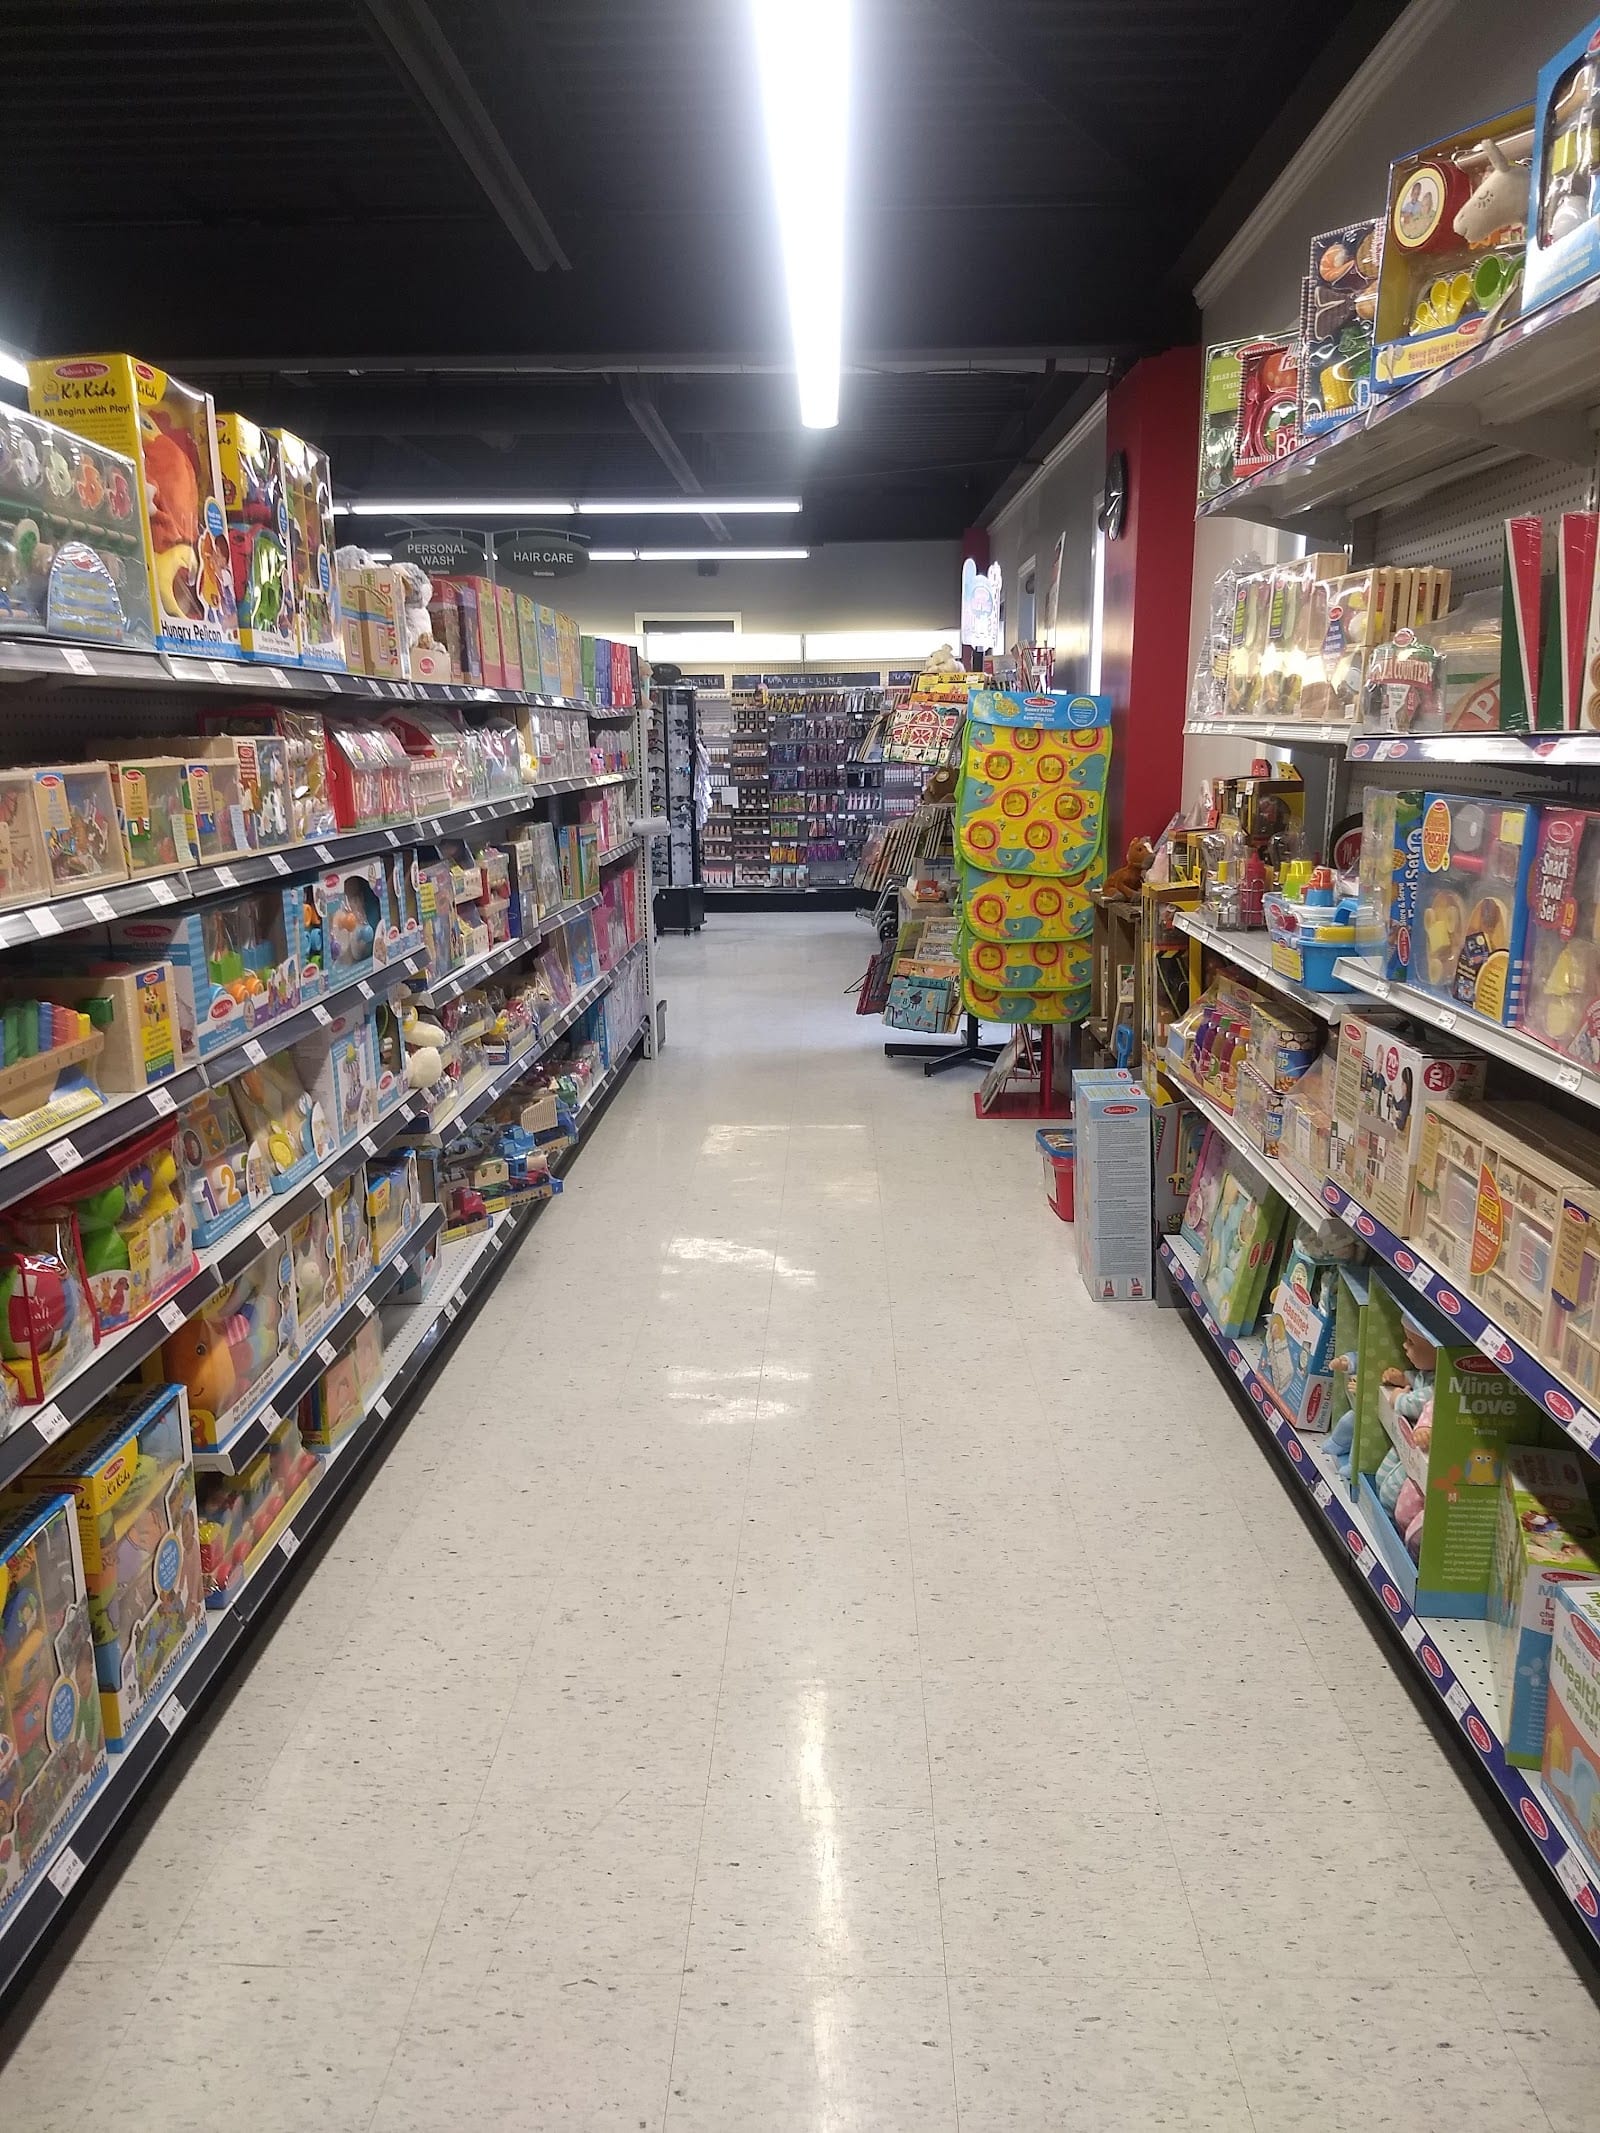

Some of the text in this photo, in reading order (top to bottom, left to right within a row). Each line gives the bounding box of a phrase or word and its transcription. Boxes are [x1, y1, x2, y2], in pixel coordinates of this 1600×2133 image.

[61, 382, 116, 399] K's Kids
[44, 408, 54, 416] All
[58, 406, 86, 417] Begins
[89, 405, 107, 415] with
[109, 405, 131, 415] Play!
[407, 543, 468, 554] PERSONAL
[513, 551, 574, 563] HAIR CARE
[421, 555, 455, 566] WASH
[161, 622, 222, 643] Hungry Pelican
[767, 675, 843, 684] MAYBELLINE
[1394, 659, 1430, 684] COUNTER
[1423, 828, 1449, 846] Pancake
[1428, 845, 1441, 863] Set
[1405, 851, 1420, 879] Set
[1541, 853, 1569, 879] Snack
[1541, 876, 1563, 901] Food
[1540, 899, 1557, 922] Set
[1428, 1062, 1443, 1089] 70+
[1282, 1298, 1310, 1338] bassinet
[1449, 1377, 1503, 1396] Mine
[1458, 1395, 1518, 1416] Love
[116, 1468, 131, 1488] Kids
[122, 1613, 207, 1732] Take-Along Safari Play Mat
[49, 1806, 72, 1841] Town
[71, 1780, 89, 1806] Play
[89, 1753, 106, 1782] Mat
